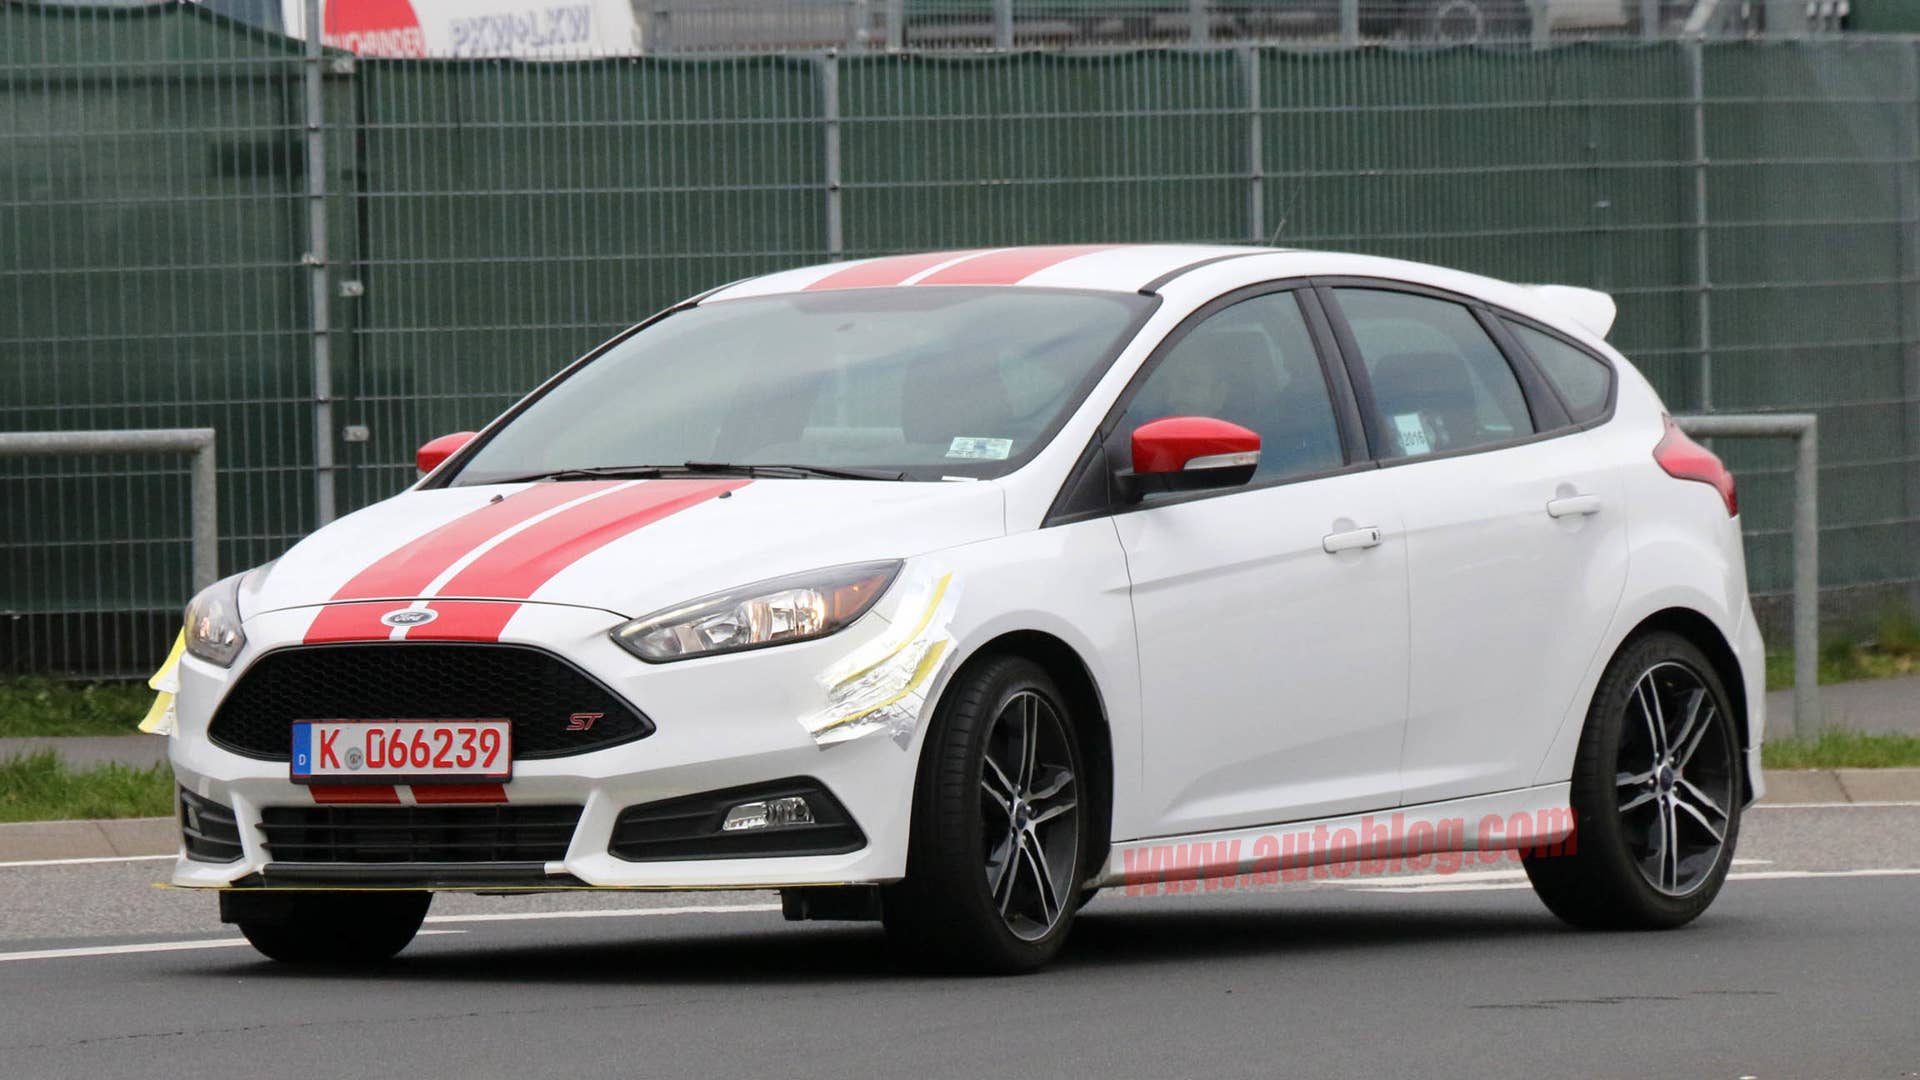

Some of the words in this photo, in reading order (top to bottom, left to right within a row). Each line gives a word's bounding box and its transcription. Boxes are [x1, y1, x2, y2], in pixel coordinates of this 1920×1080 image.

[566, 712, 604, 731] ST
[320, 729, 341, 769] K
[366, 728, 501, 769] 066239
[299, 754, 306, 766] D
